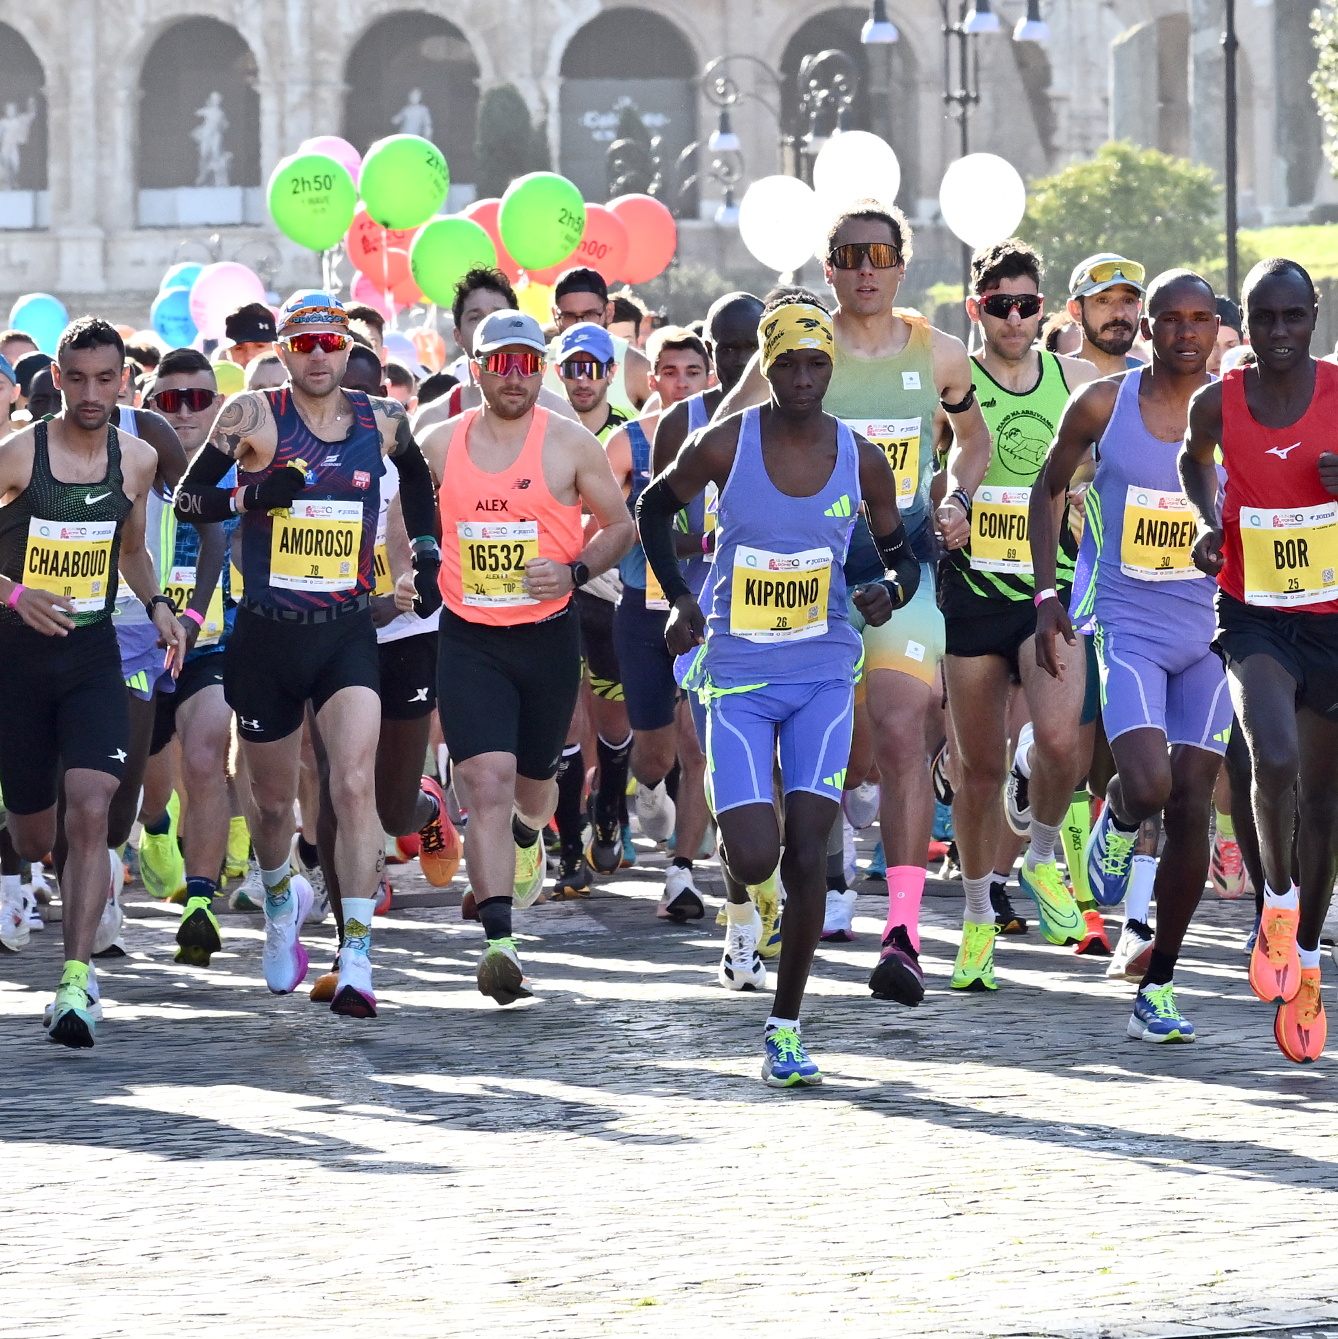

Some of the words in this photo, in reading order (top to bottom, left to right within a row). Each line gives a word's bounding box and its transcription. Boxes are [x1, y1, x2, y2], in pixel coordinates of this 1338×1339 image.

[476, 499, 508, 511] ALEX
[279, 527, 353, 557] AMOROSO
[1274, 539, 1309, 569] BOR
[29, 547, 107, 577] CHAABOUD
[310, 565, 319, 575] 78
[468, 544, 525, 572] 16532
[745, 578, 819, 608] KIPRONO
[1288, 578, 1299, 589] 25
[776, 617, 787, 627] 26
